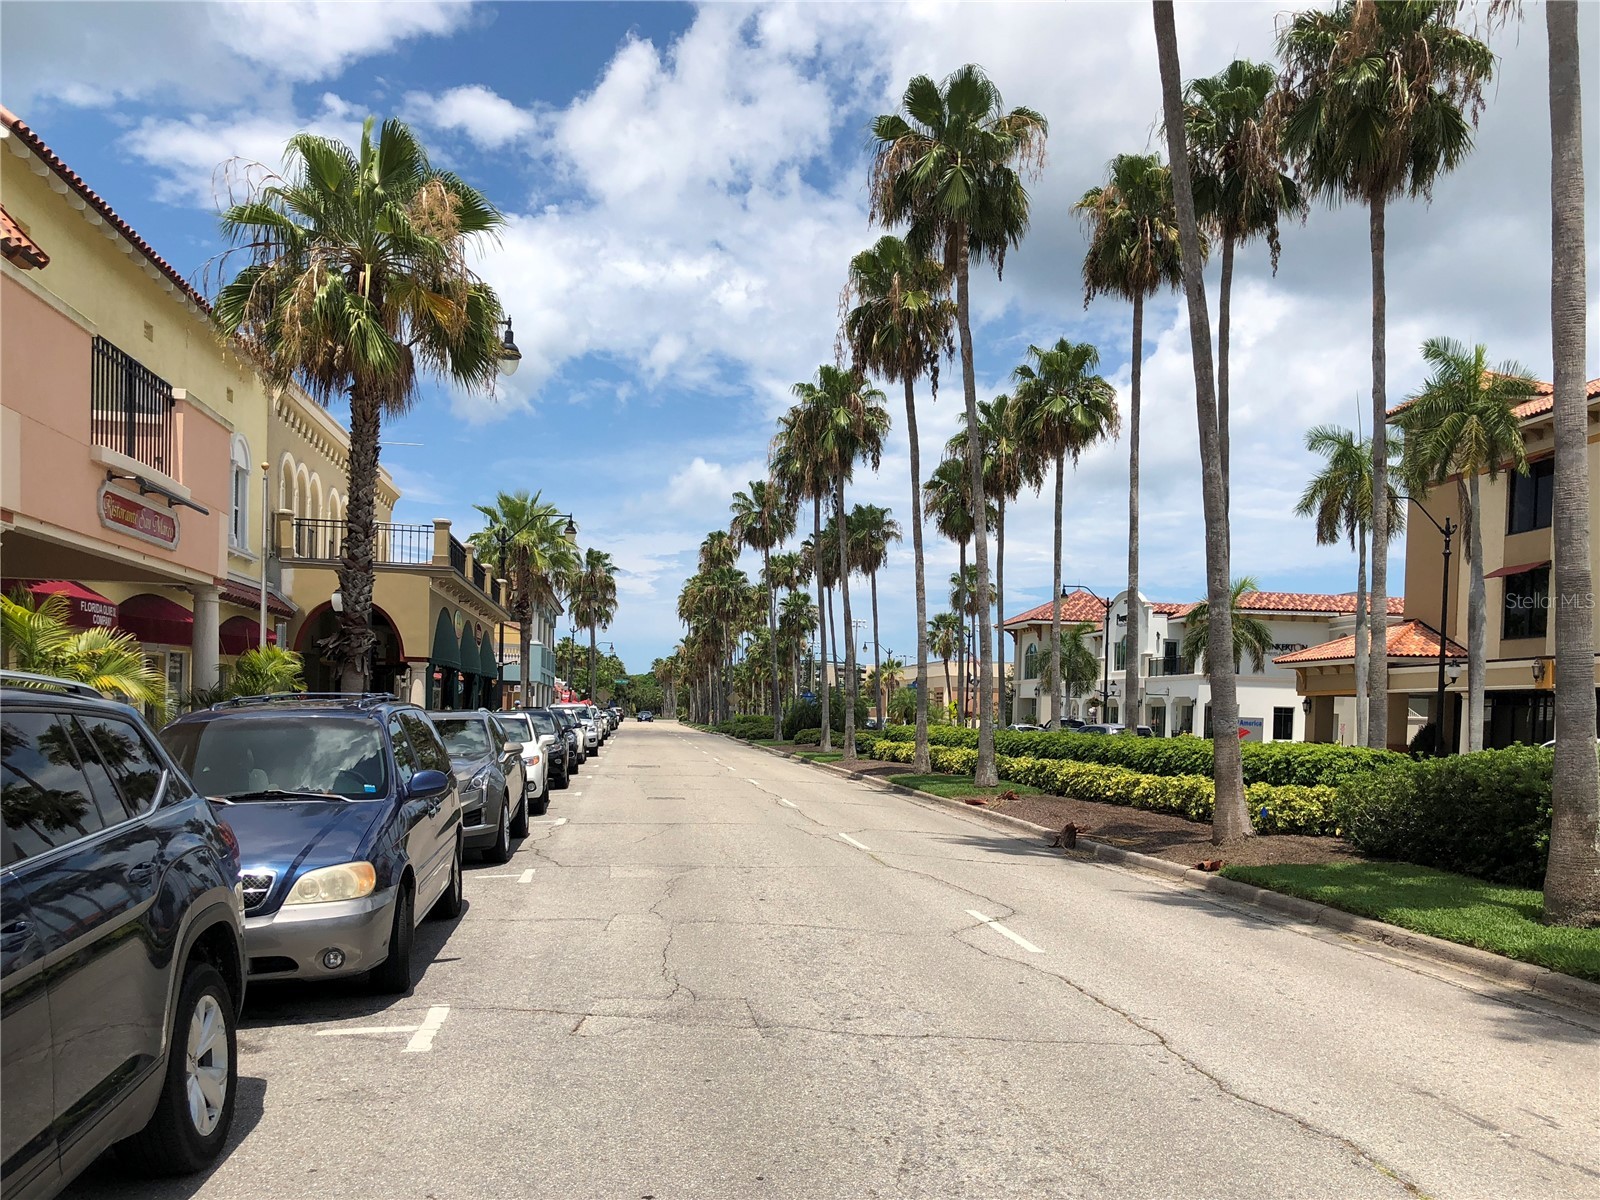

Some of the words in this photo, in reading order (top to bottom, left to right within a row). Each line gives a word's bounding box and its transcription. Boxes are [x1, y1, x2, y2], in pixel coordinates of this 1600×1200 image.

[138, 507, 152, 530] San
[152, 514, 174, 539] Marco
[80, 600, 103, 614] FLORIDA
[92, 614, 112, 626] COMPANY
